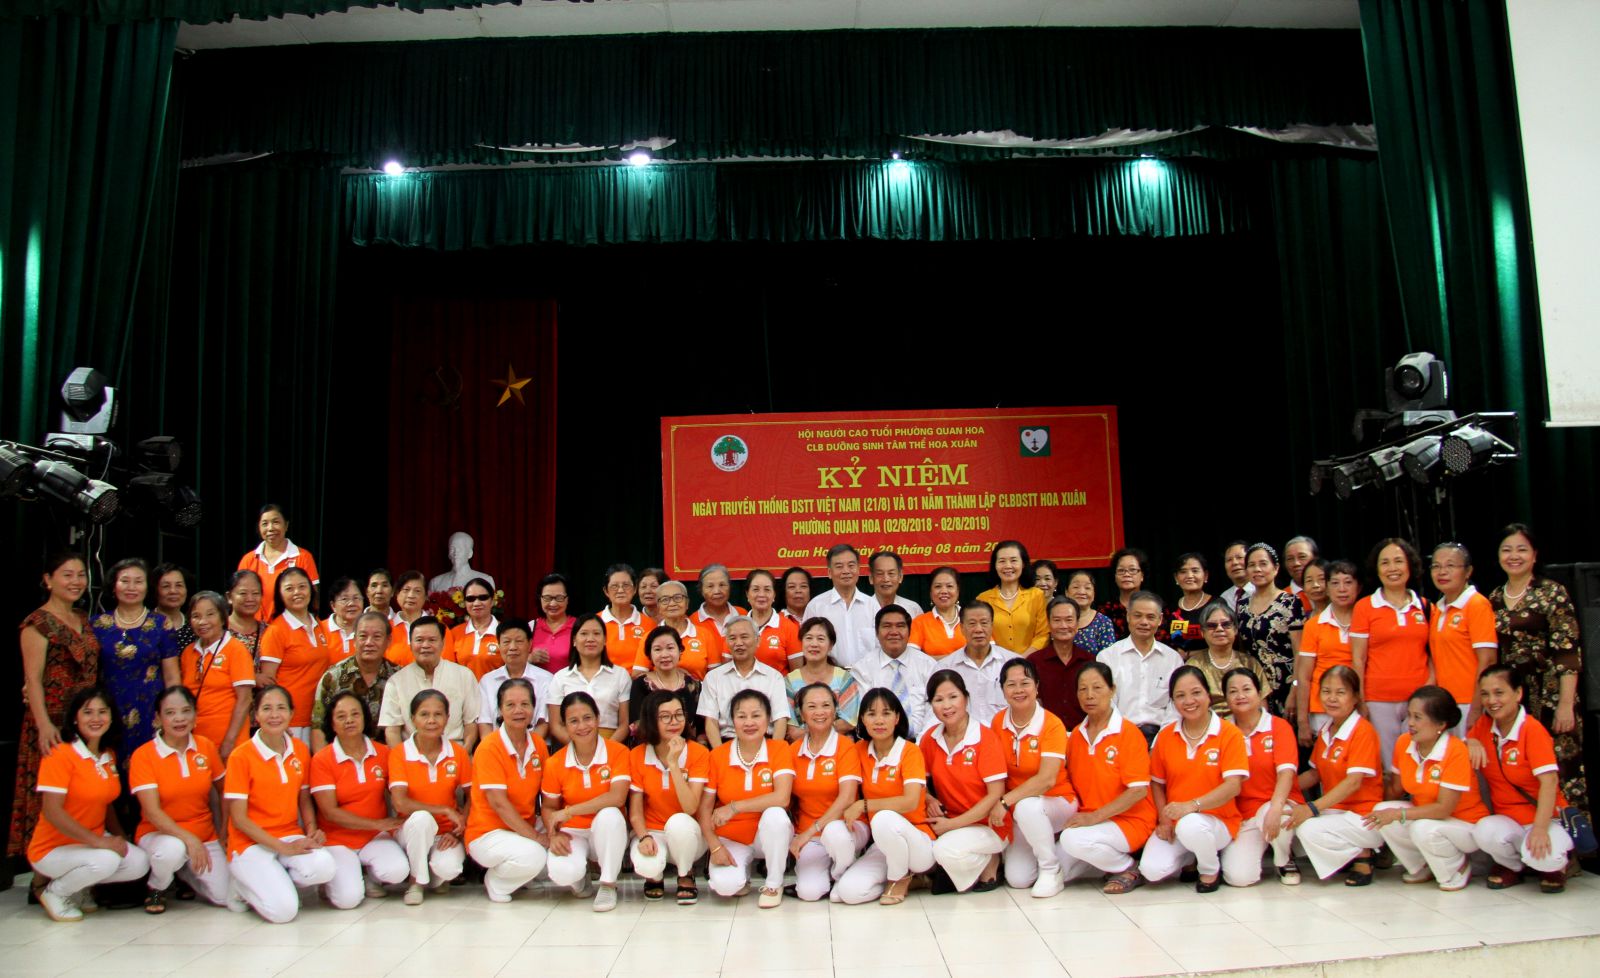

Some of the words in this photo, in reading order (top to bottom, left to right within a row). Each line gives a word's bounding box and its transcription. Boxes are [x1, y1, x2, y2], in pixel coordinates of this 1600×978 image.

[798, 428, 814, 440] HỘI
[816, 427, 846, 438] NGƯỜI
[848, 429, 869, 438] CAO
[870, 424, 892, 437] TUỔI
[894, 426, 934, 436] PHƯỜNG
[935, 427, 963, 435] QUAN
[965, 426, 985, 434] HOA
[806, 443, 824, 452] CLB
[826, 440, 860, 451] DƯỠNG
[862, 441, 884, 450] SINH
[886, 440, 907, 449] TÂM
[928, 440, 949, 449] HOA
[950, 438, 978, 448] XUÂN
[817, 455, 867, 489] KỶ
[877, 457, 969, 492] NIỆM
[692, 498, 718, 517] NGÀY
[719, 495, 756, 516] TRUYỀN
[758, 494, 789, 515] THỐNG
[791, 498, 815, 514] DSTT
[816, 495, 837, 516] VIỆT
[838, 497, 861, 512] NAM
[863, 496, 891, 512] (21/8)
[892, 493, 906, 511] VÀ
[907, 496, 918, 511] 01
[921, 493, 944, 510] NĂM
[945, 492, 977, 509] THÀNH
[978, 491, 996, 511] LẬP
[998, 492, 1038, 508] CLBDSTT
[1040, 492, 1059, 507] HOA
[1061, 488, 1087, 506] XUÂN
[792, 516, 831, 535] PHƯỜNG
[833, 519, 860, 535] QUAN
[861, 519, 881, 534] HOA
[883, 517, 933, 534] (02/8/2018
[940, 515, 990, 532] 02/8/2019)
[777, 547, 810, 558] Quan
[813, 546, 829, 557] Ho
[896, 543, 932, 556] tháng
[935, 543, 951, 554] 08
[954, 542, 981, 553] năm
